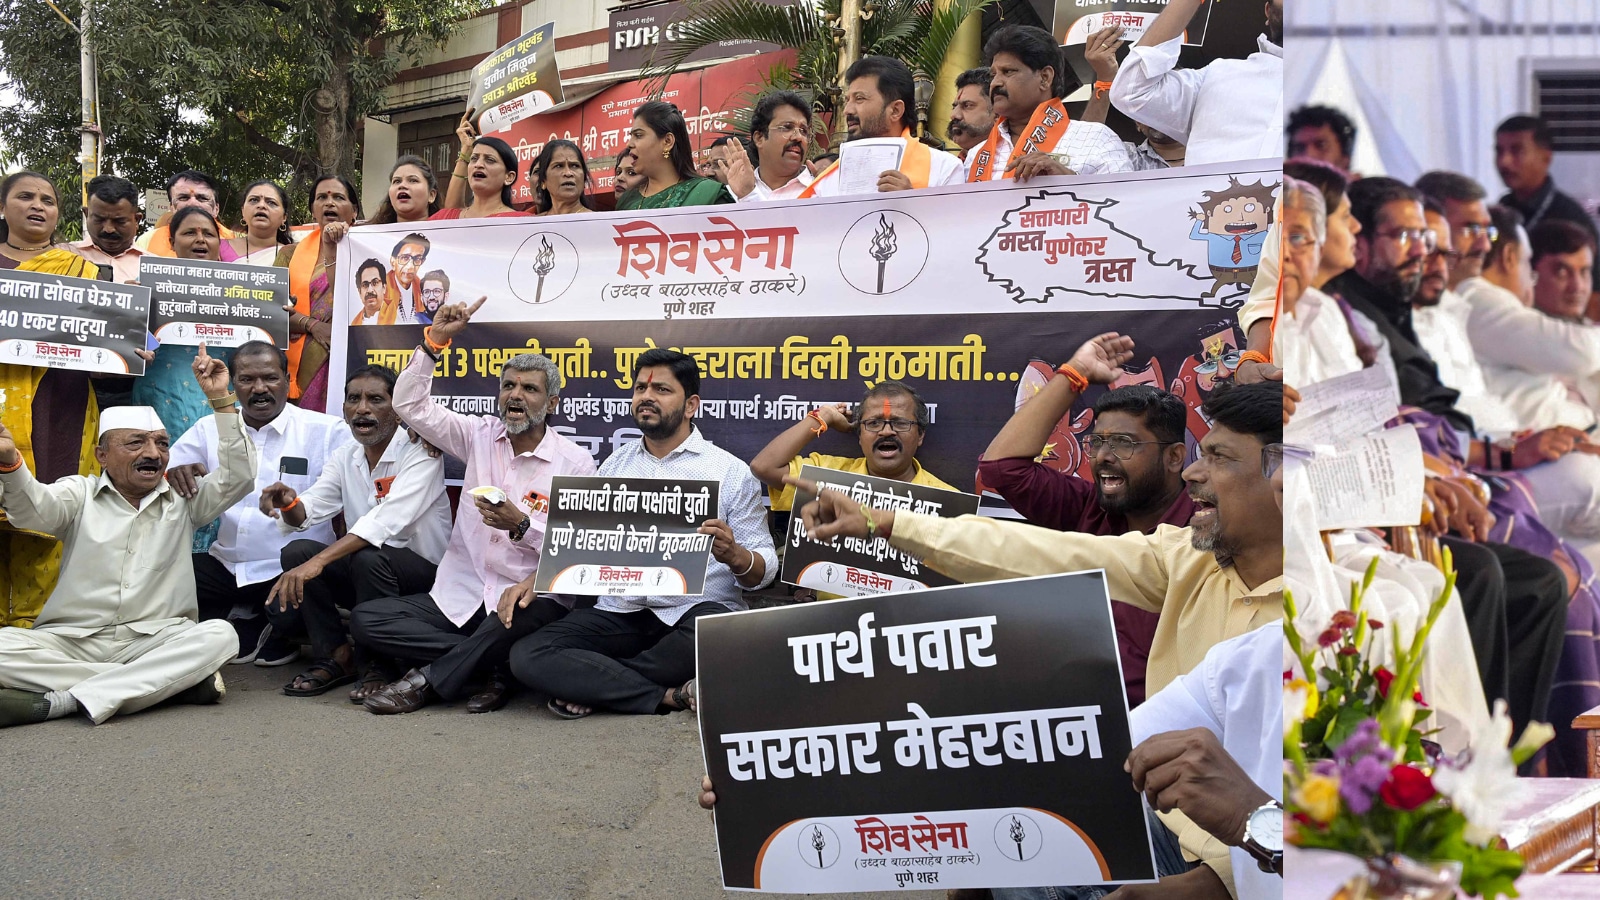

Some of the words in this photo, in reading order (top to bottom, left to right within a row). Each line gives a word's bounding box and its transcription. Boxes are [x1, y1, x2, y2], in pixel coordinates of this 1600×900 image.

[1102, 12, 1145, 27] शिवसेना
[517, 31, 544, 54] भूखंड
[615, 26, 660, 50] FISH
[484, 66, 506, 90] युतीत
[507, 52, 537, 73] मिळून
[482, 86, 505, 105] खाऊ
[506, 72, 538, 94] श्रीखंड
[498, 99, 525, 116] शिवसेना
[601, 100, 614, 113] पुणे
[601, 129, 620, 150] दत्त
[1019, 203, 1090, 228] सत्ताधारी
[613, 217, 799, 280] शिवसेना
[998, 230, 1046, 253] मस्त
[1045, 233, 1108, 264] पुणेकर
[141, 263, 185, 276] शासनाचा
[187, 266, 212, 279] महार
[214, 268, 248, 281] वतनाचा
[250, 271, 276, 286] भूखंड
[1083, 258, 1136, 284] त्रस्त
[43, 280, 85, 304] सोबत
[87, 284, 113, 307] घेऊ
[115, 293, 133, 309] या
[155, 280, 188, 294] सत्तेच्या
[190, 283, 222, 297] मस्तीत
[223, 285, 250, 299] अजित
[251, 290, 273, 301] पवार
[659, 276, 744, 299] बाळासाहेब
[749, 275, 807, 297] ठाकरे)
[199, 302, 229, 316] खाल्ले
[231, 304, 260, 318] श्रीखंड
[664, 299, 685, 320] पुणे
[688, 302, 716, 316] शहर
[22, 312, 59, 331] एकर
[60, 316, 107, 342] लाटुया
[195, 323, 234, 337] शिवसेना
[36, 342, 81, 358] शिवसेना
[455, 348, 469, 379] 3
[780, 336, 852, 380] दिली
[452, 395, 496, 413] वतनाचा
[564, 393, 600, 421] भुखंड
[729, 394, 760, 419] पार्थ
[558, 483, 611, 512] सत्ताधारी
[613, 484, 640, 513] तीन
[641, 486, 683, 515] पक्षांची
[684, 487, 711, 523] युती
[549, 522, 575, 556] पुणे
[575, 524, 625, 552] शहराची
[625, 525, 658, 553] केली
[599, 566, 643, 582] शिवसेना
[846, 567, 893, 591] शिवसेना
[788, 612, 876, 683] पार्थ
[882, 615, 998, 675] पवार
[721, 721, 882, 782] सरकार
[886, 702, 1103, 770] मेहरबान
[854, 815, 969, 855] शिवसेना
[890, 853, 943, 867] बाळासाहेब
[946, 851, 981, 866] ठाकरे)
[895, 869, 914, 888] पुणे
[916, 872, 939, 884] शहर
